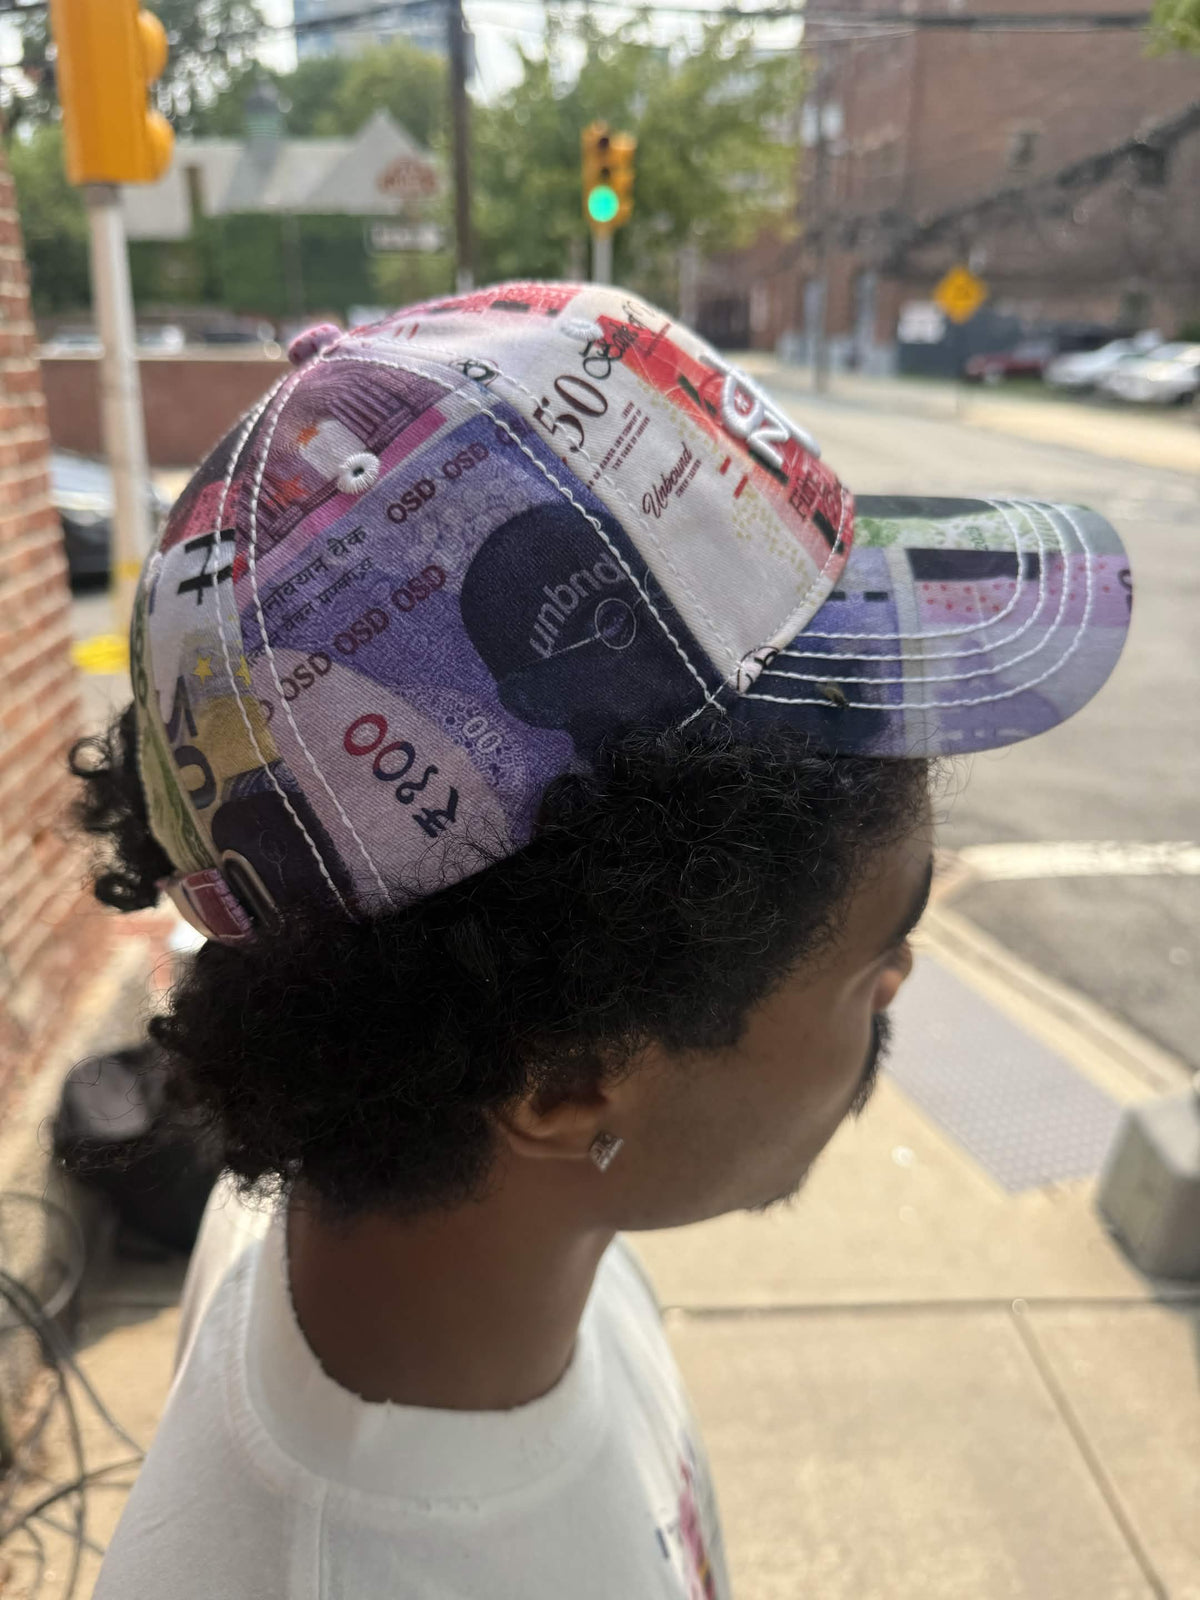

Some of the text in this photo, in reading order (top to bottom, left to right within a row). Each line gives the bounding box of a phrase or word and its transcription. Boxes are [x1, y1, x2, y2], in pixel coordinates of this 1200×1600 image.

[386, 440, 491, 525] OSD OSD
[642, 441, 694, 519] Unbound
[279, 650, 334, 701] OSD
[332, 607, 391, 656] OSD
[390, 563, 447, 613] OSD
